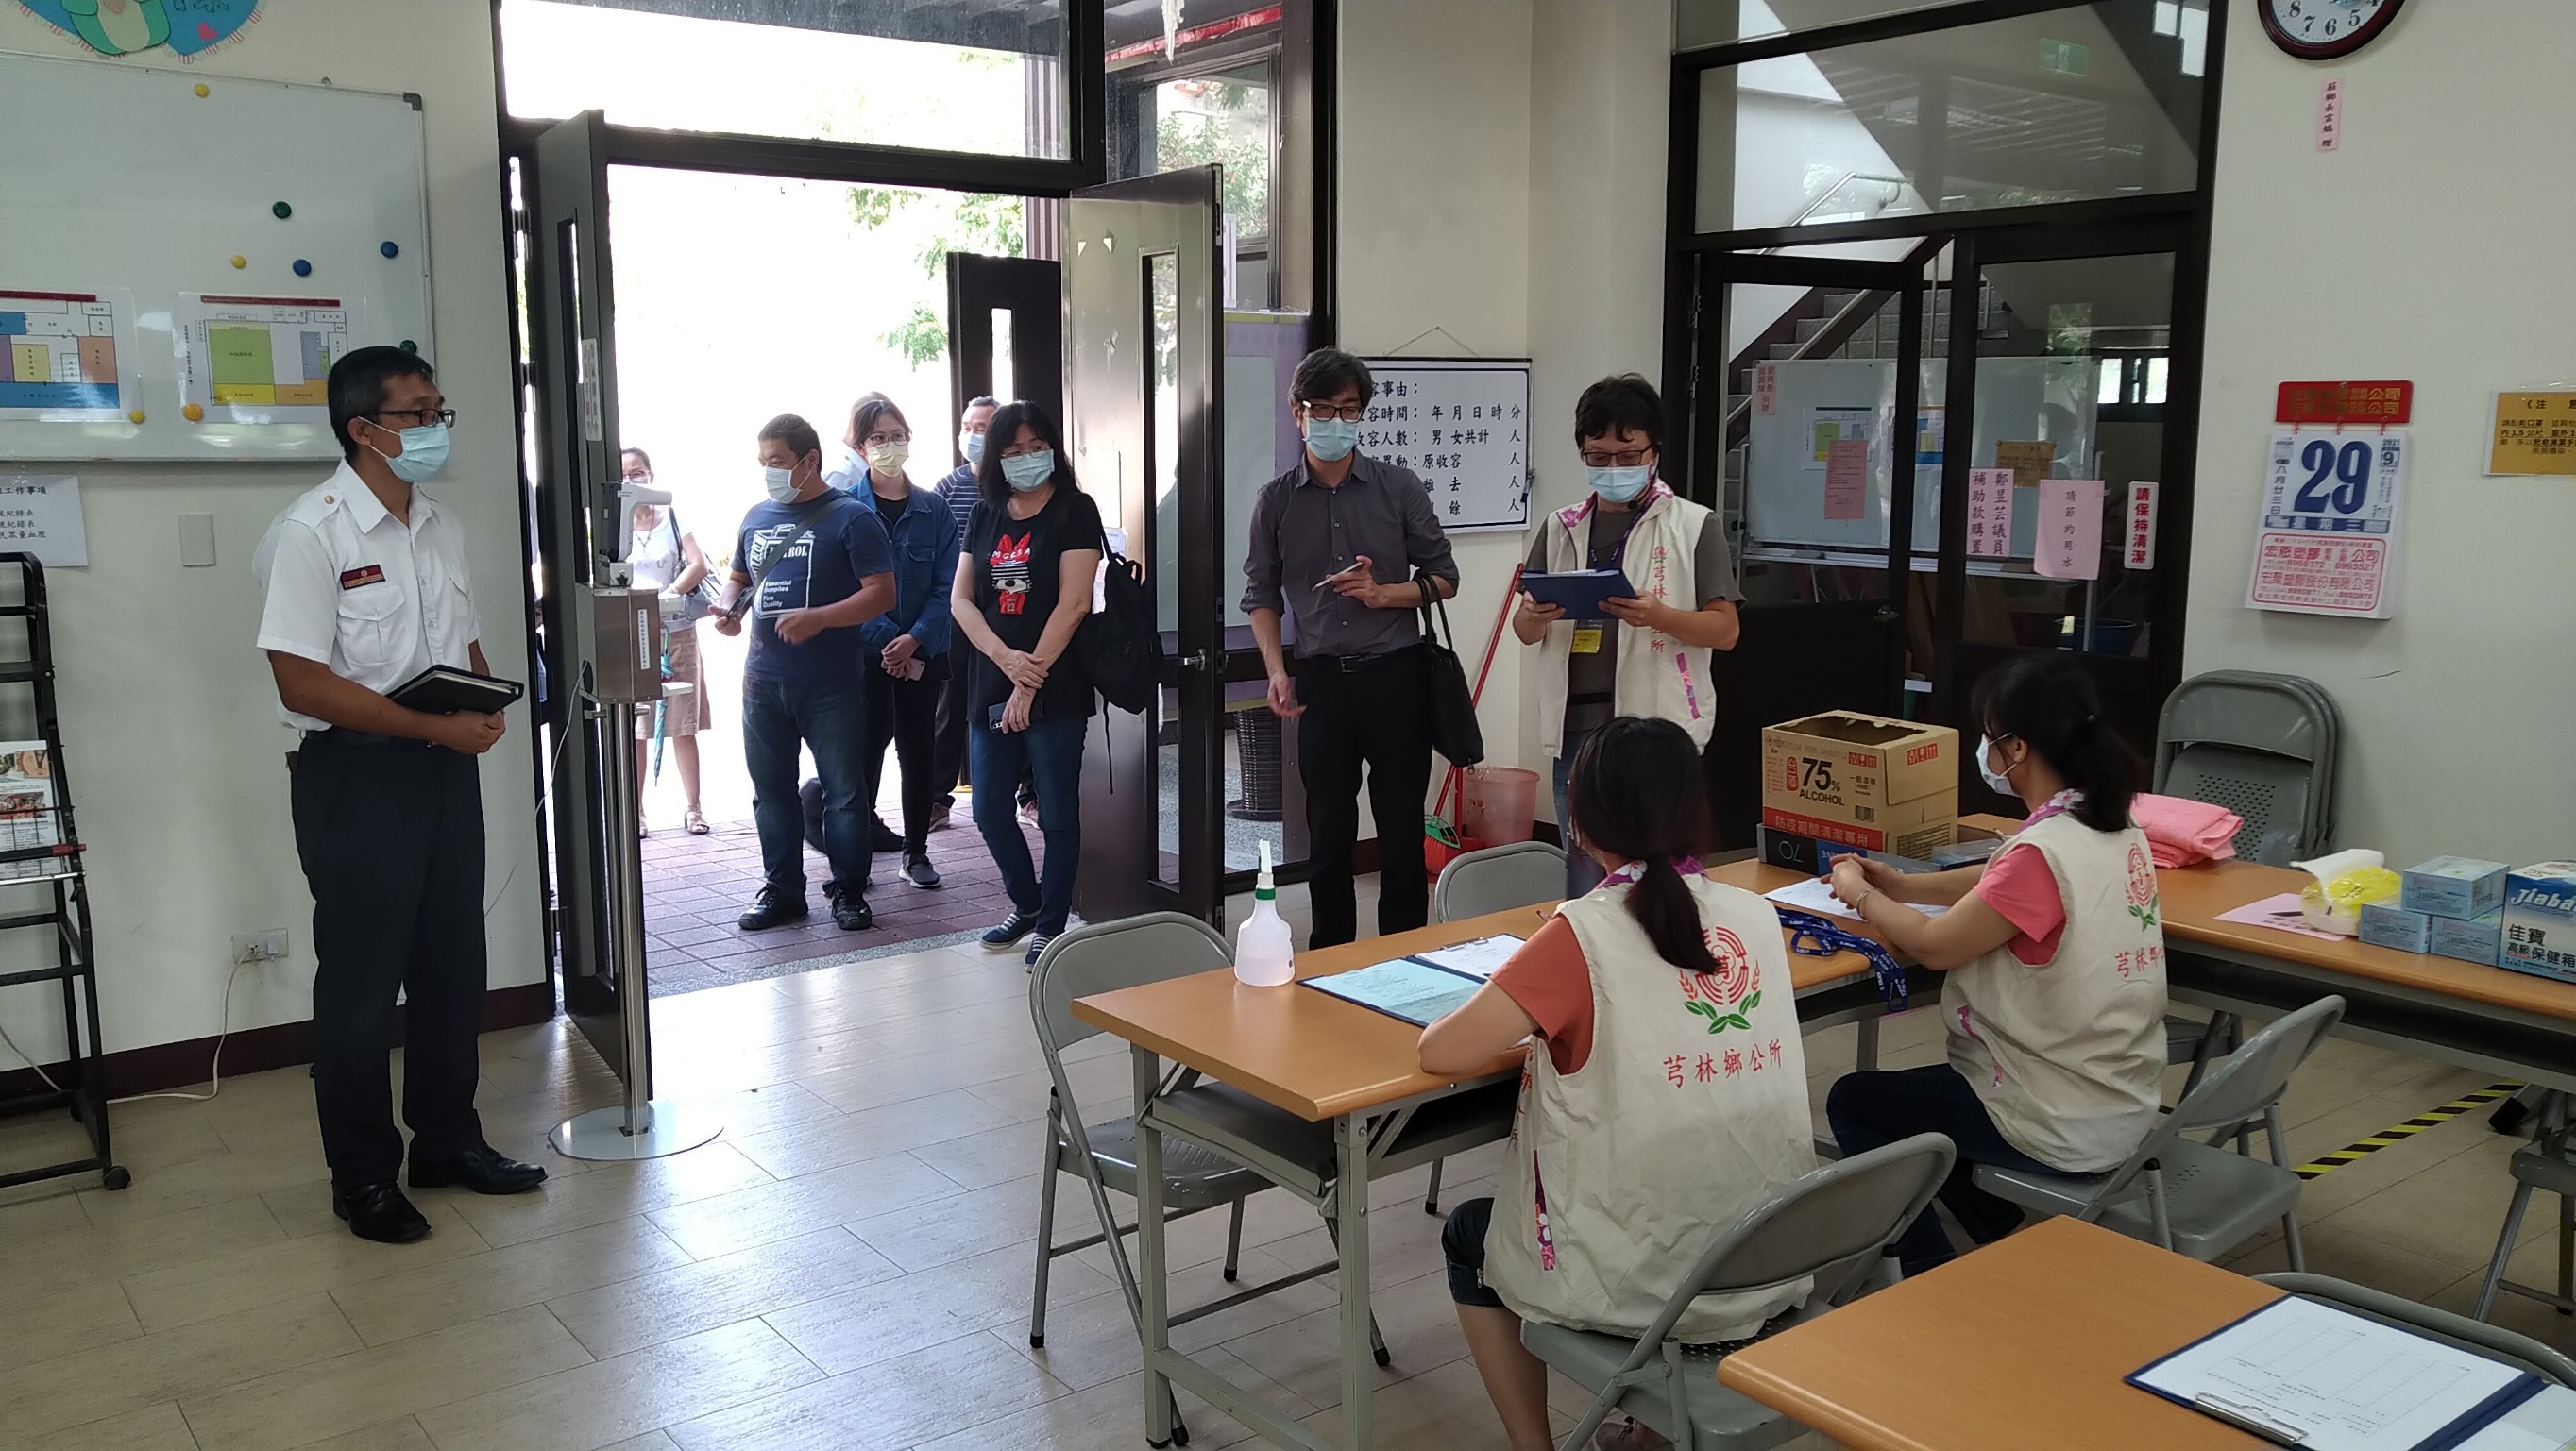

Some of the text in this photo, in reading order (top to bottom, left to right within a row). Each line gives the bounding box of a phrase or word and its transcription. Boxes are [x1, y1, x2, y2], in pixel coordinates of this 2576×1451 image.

[2304, 15, 2315, 32] 7
[2348, 9, 2361, 26] 5
[2325, 18, 2337, 35] 6
[1432, 405, 1443, 421] 年
[1452, 405, 1462, 420] 月
[1472, 406, 1482, 419] 日
[1491, 404, 1502, 419] 時
[1511, 403, 1521, 419] 分
[1432, 430, 1442, 446] 男
[1509, 430, 1521, 443] 人
[1508, 452, 1520, 465] 人
[1449, 477, 1461, 492] 去
[1508, 476, 1520, 489] 人
[2294, 439, 2372, 514] 29
[1449, 500, 1461, 515] 餘
[1507, 498, 1519, 512] 人
[2131, 487, 2151, 565] 請保持清潔
[1799, 789, 1845, 806] ALCOHOL
[2511, 888, 2576, 912] Jiaba
[2508, 924, 2546, 946] 佳寶
[1663, 1038, 1782, 1088] 芎林鄉公所
